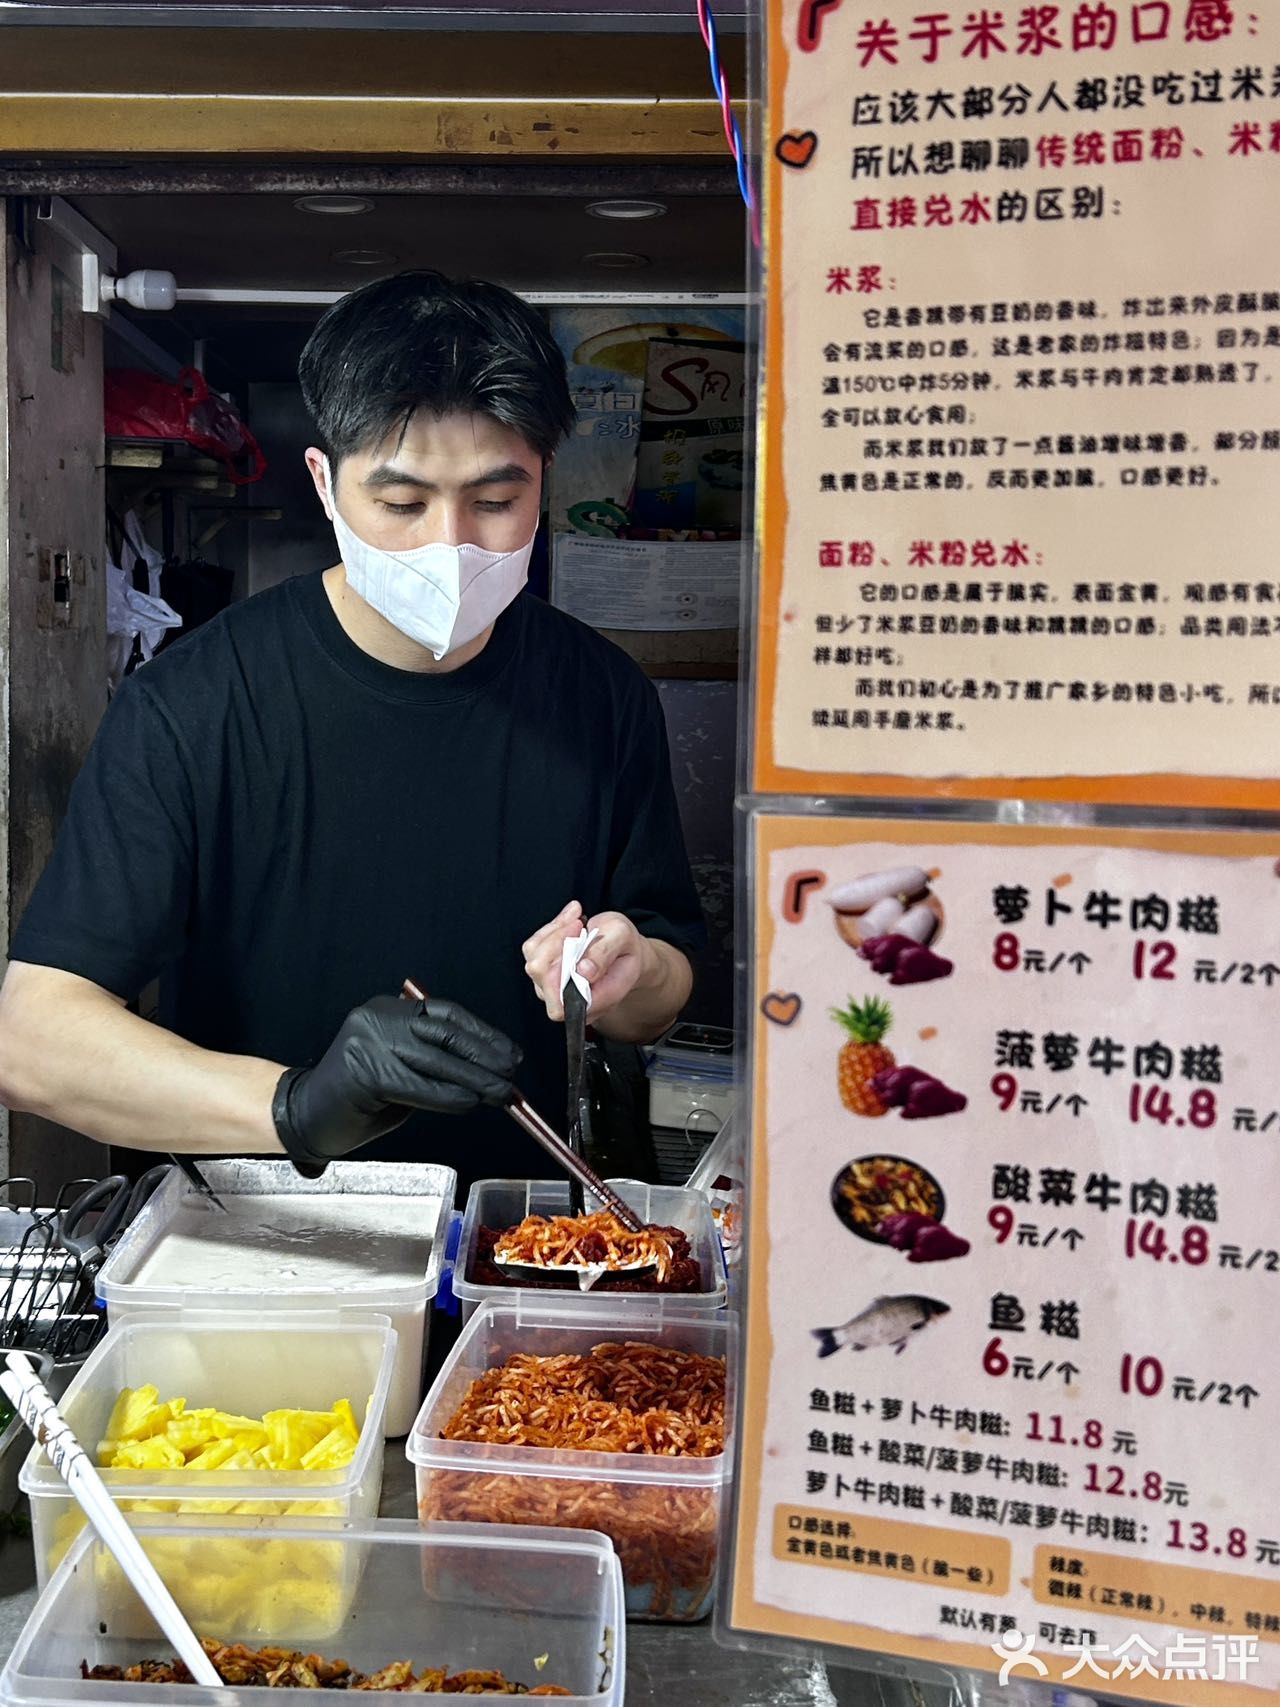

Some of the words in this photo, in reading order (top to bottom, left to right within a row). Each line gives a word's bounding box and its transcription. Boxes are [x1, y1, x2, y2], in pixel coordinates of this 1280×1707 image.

[856, 0, 1258, 68] 关于米浆的口感：
[851, 121, 1280, 180] 所以想聊聊传统面粉、米
[850, 186, 1120, 231] 直接兑水的区别：
[825, 265, 895, 295] 米浆：
[818, 539, 1042, 568] 面粉、米粉兑水：
[992, 884, 1219, 935] 萝卜牛肉糍
[995, 1029, 1222, 1084] 菠萝牛肉糍
[992, 1164, 1218, 1222] 酸菜牛肉糍
[988, 1292, 1080, 1340] 鱼糍
